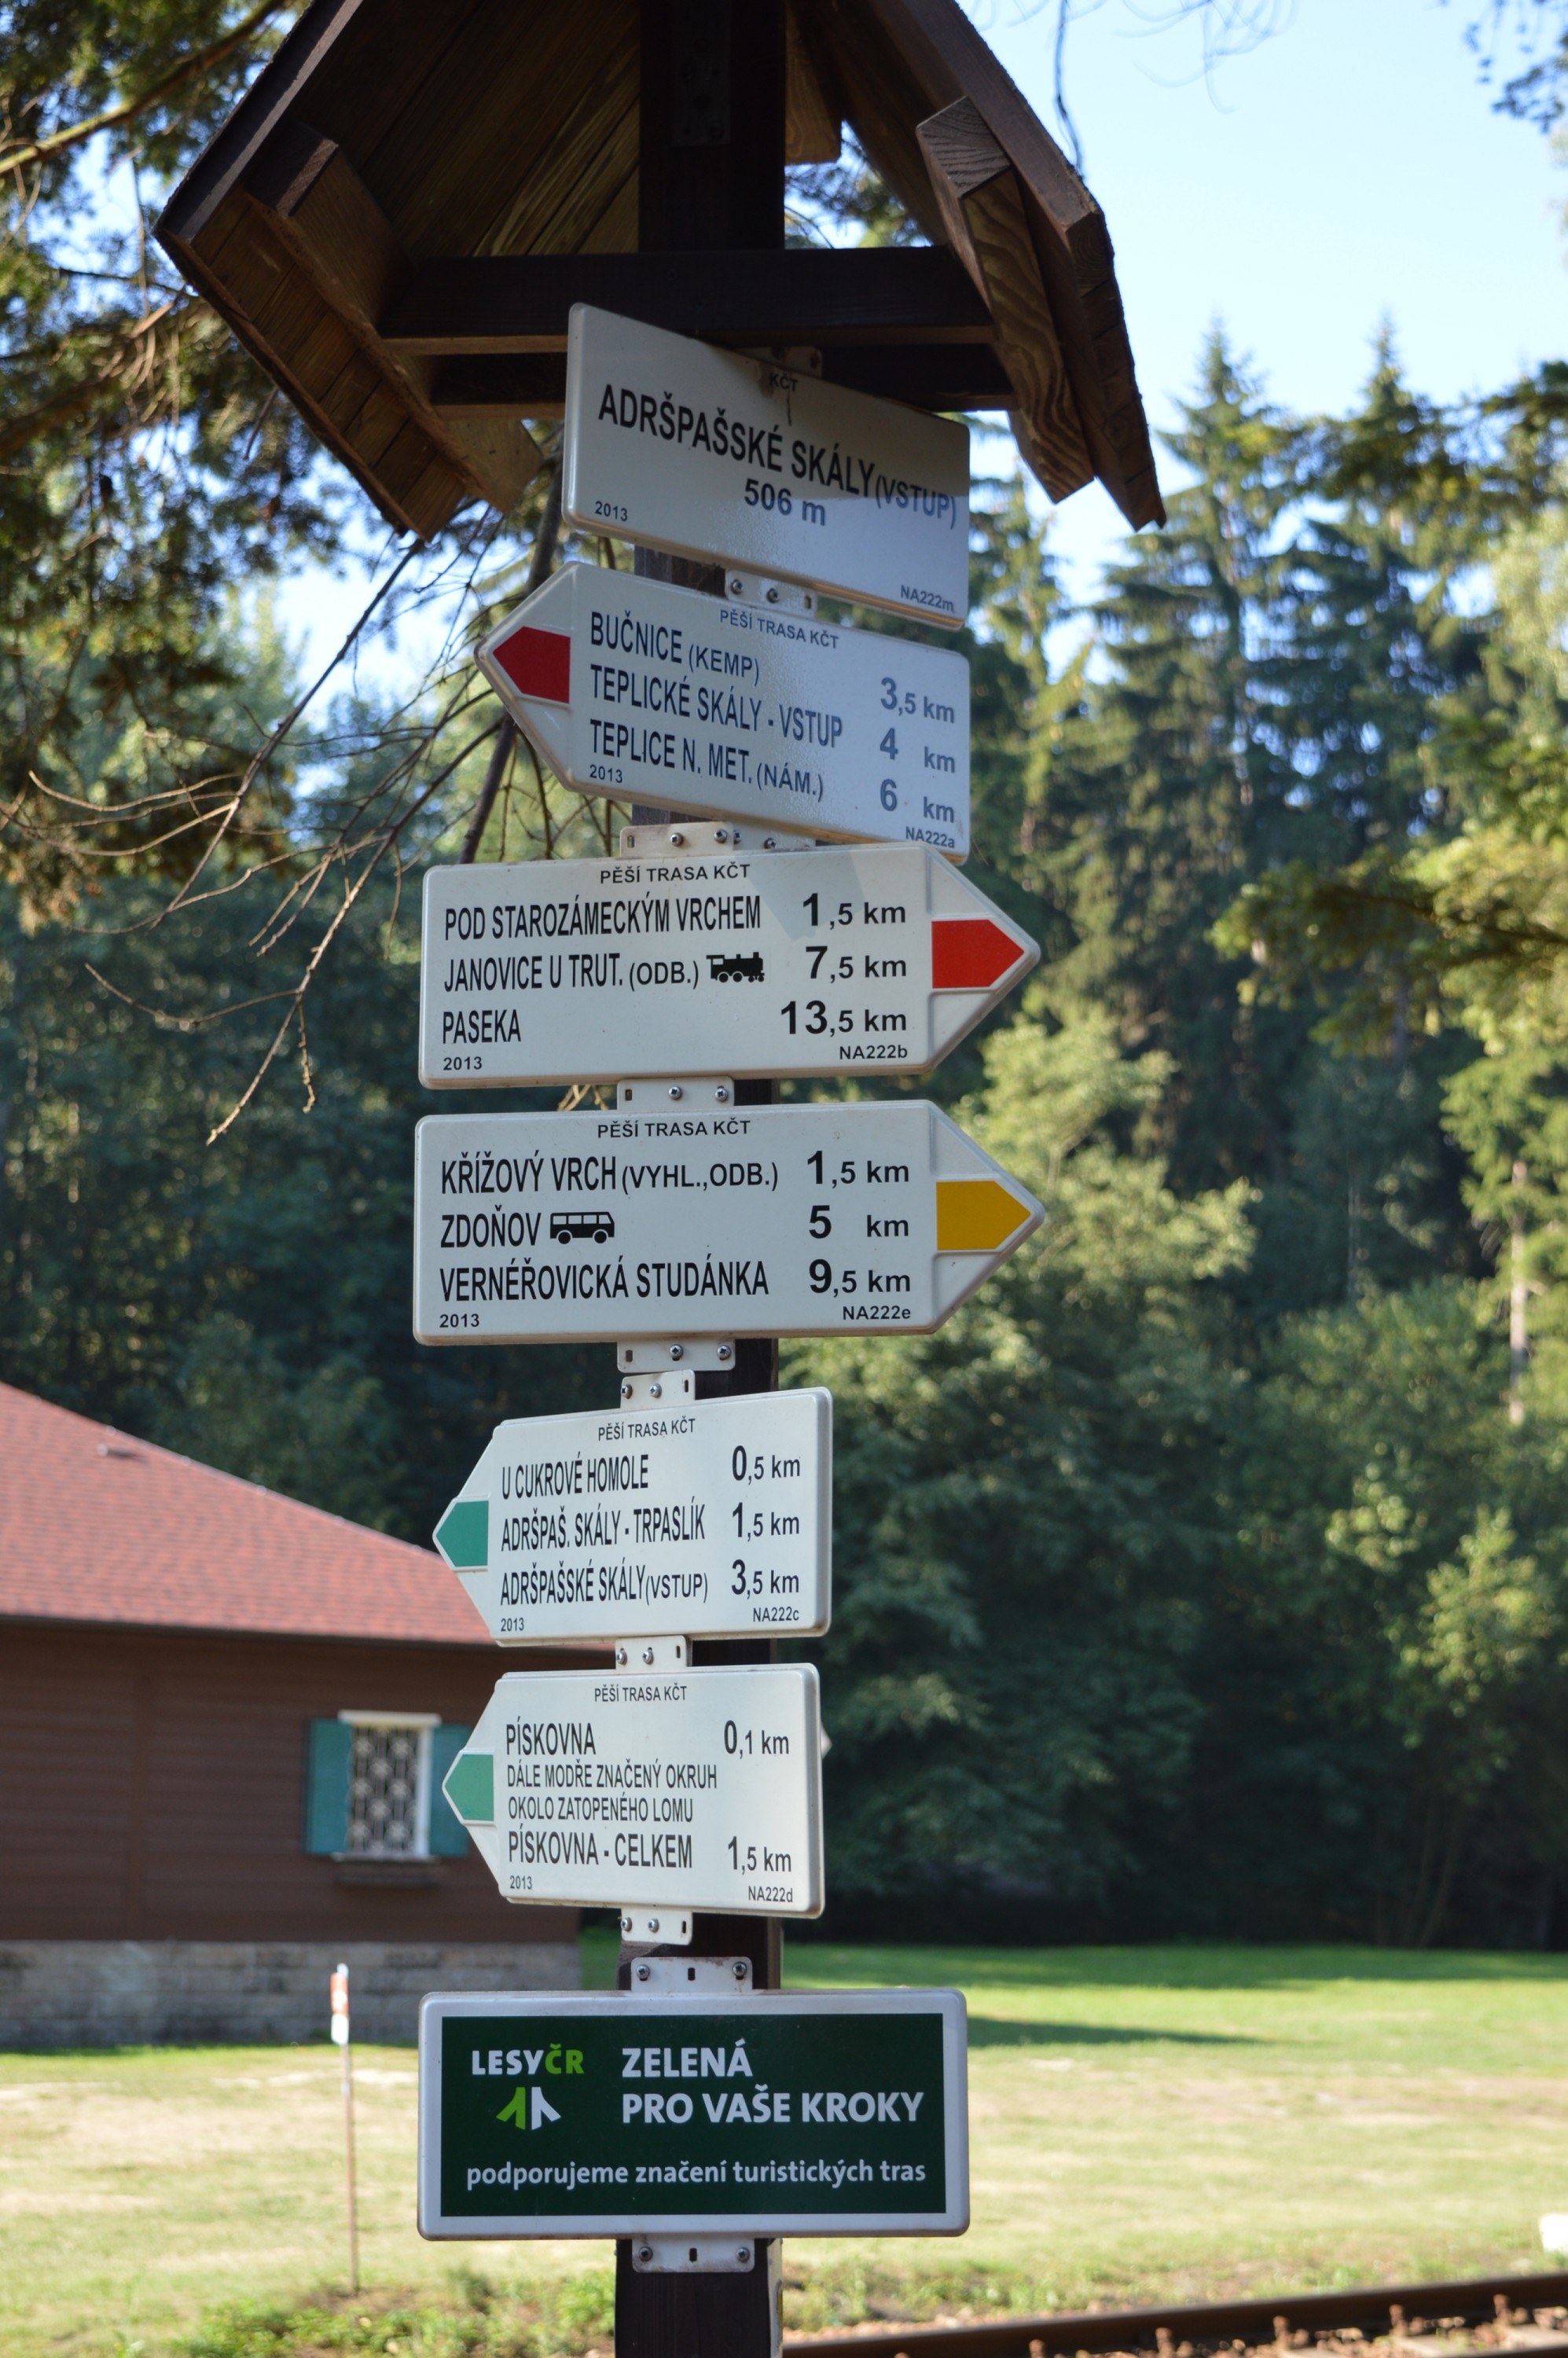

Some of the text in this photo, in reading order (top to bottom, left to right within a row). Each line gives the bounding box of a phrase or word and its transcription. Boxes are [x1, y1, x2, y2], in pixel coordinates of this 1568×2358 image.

[769, 371, 799, 392] KČT
[597, 384, 783, 472] ADRŠPAŠSKÉ
[595, 501, 628, 521] 2013
[744, 479, 826, 526] 506 m
[900, 585, 954, 612] NA222m
[720, 608, 839, 648] PĚŠÍ TRASA KČT
[591, 610, 954, 723] BUČNICE (KEMP) 3,5 km
[590, 664, 690, 718] TEPLICKÉ
[698, 685, 762, 732] SKÁLY
[779, 705, 843, 748] VSTUP
[879, 728, 898, 760] 4
[924, 747, 955, 773] km
[589, 719, 954, 824] TEPLICE N. MET. (NÁM.) 6 km
[589, 764, 623, 784] 2013
[905, 827, 955, 849] NA222a
[600, 863, 751, 884] PĚŠÍ TRASA KČT
[445, 891, 906, 941] POD STAROZÁMECKÝM VRCHEM 1,5 km
[444, 946, 907, 992] JANOVICE U TRUT. (ODB.) 7,5 km
[442, 1001, 907, 1045] PASEKA 13,5 km
[442, 1056, 483, 1071] 2013
[839, 1044, 908, 1061] NA222b
[597, 1119, 751, 1139] PĚŠÍ TRASA KČT
[441, 1149, 542, 1195] KŘÍŽOVÝ
[551, 1156, 616, 1191] VRCH
[806, 1150, 855, 1188] 1,5
[867, 1160, 909, 1183] km
[439, 1204, 909, 1248] ZDOŇOV 5 km
[439, 1253, 911, 1302] VERNÉŘOVICKÁ STUDÁNKA 9,5 km
[439, 1313, 480, 1328] 2013
[842, 1304, 911, 1321] NA222e
[598, 1418, 696, 1442] PĚŠÍ TRASA KČT
[501, 1445, 800, 1500] U CUKROVÉ HOMOLE 0,5 km
[501, 1505, 571, 1552] ADRŠPAŠ.
[575, 1504, 621, 1548] SKÁLY
[634, 1497, 705, 1544] TRPASLÍK
[732, 1502, 764, 1542] 1,5
[771, 1511, 799, 1536] km
[501, 1560, 593, 1606] ADRŠPAŠSKÉ
[731, 1559, 763, 1599] 3,5
[770, 1570, 799, 1594] km
[501, 1617, 524, 1632] 2013
[753, 1607, 799, 1622] NA222c
[594, 1682, 687, 1702] PĚŠÍ TRASA KČT
[506, 1716, 789, 1759] PÍSKOVNA 0,1 km
[507, 1758, 717, 1789] DÁLE MODŘE ZNAČENÝ OKRUH
[509, 1791, 692, 1823] OKOLO ZATOPENÉHO LOMU
[509, 1824, 599, 1865] PÍSKOVNA
[615, 1833, 692, 1868] CELKEM
[728, 1836, 757, 1875] 1,5
[764, 1847, 791, 1871] km
[509, 1875, 533, 1890] 2013
[748, 1886, 793, 1904] NA222d
[622, 2037, 753, 2077] ZELENÁ
[622, 2084, 924, 2124] PRO VAŠE KROKY
[468, 2159, 926, 2191] podporujeme značení turistických tras
